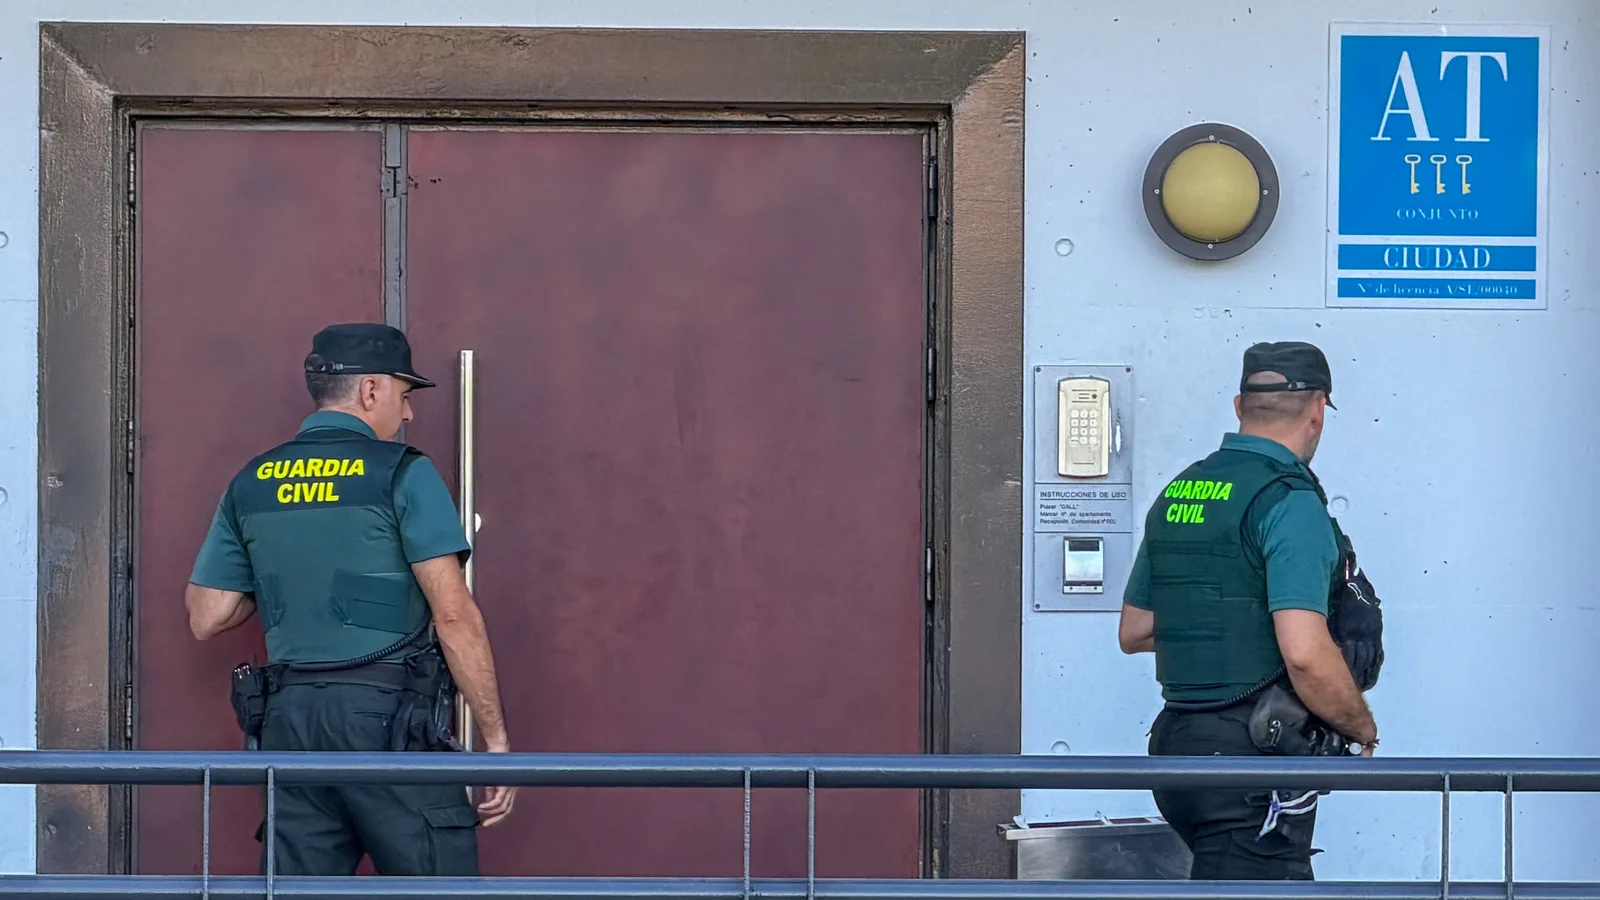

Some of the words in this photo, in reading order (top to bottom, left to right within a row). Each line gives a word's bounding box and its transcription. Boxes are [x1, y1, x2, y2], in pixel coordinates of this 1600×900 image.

[1370, 50, 1508, 142] AT
[1396, 208, 1479, 220] CONJUNTO
[1383, 247, 1491, 269] CIUDAD
[1375, 283, 1390, 294] de
[256, 458, 365, 480] GUARDIA
[277, 482, 340, 503] CIVIL
[1164, 480, 1233, 500] GUARDIA
[1166, 503, 1205, 523] CIVIL
